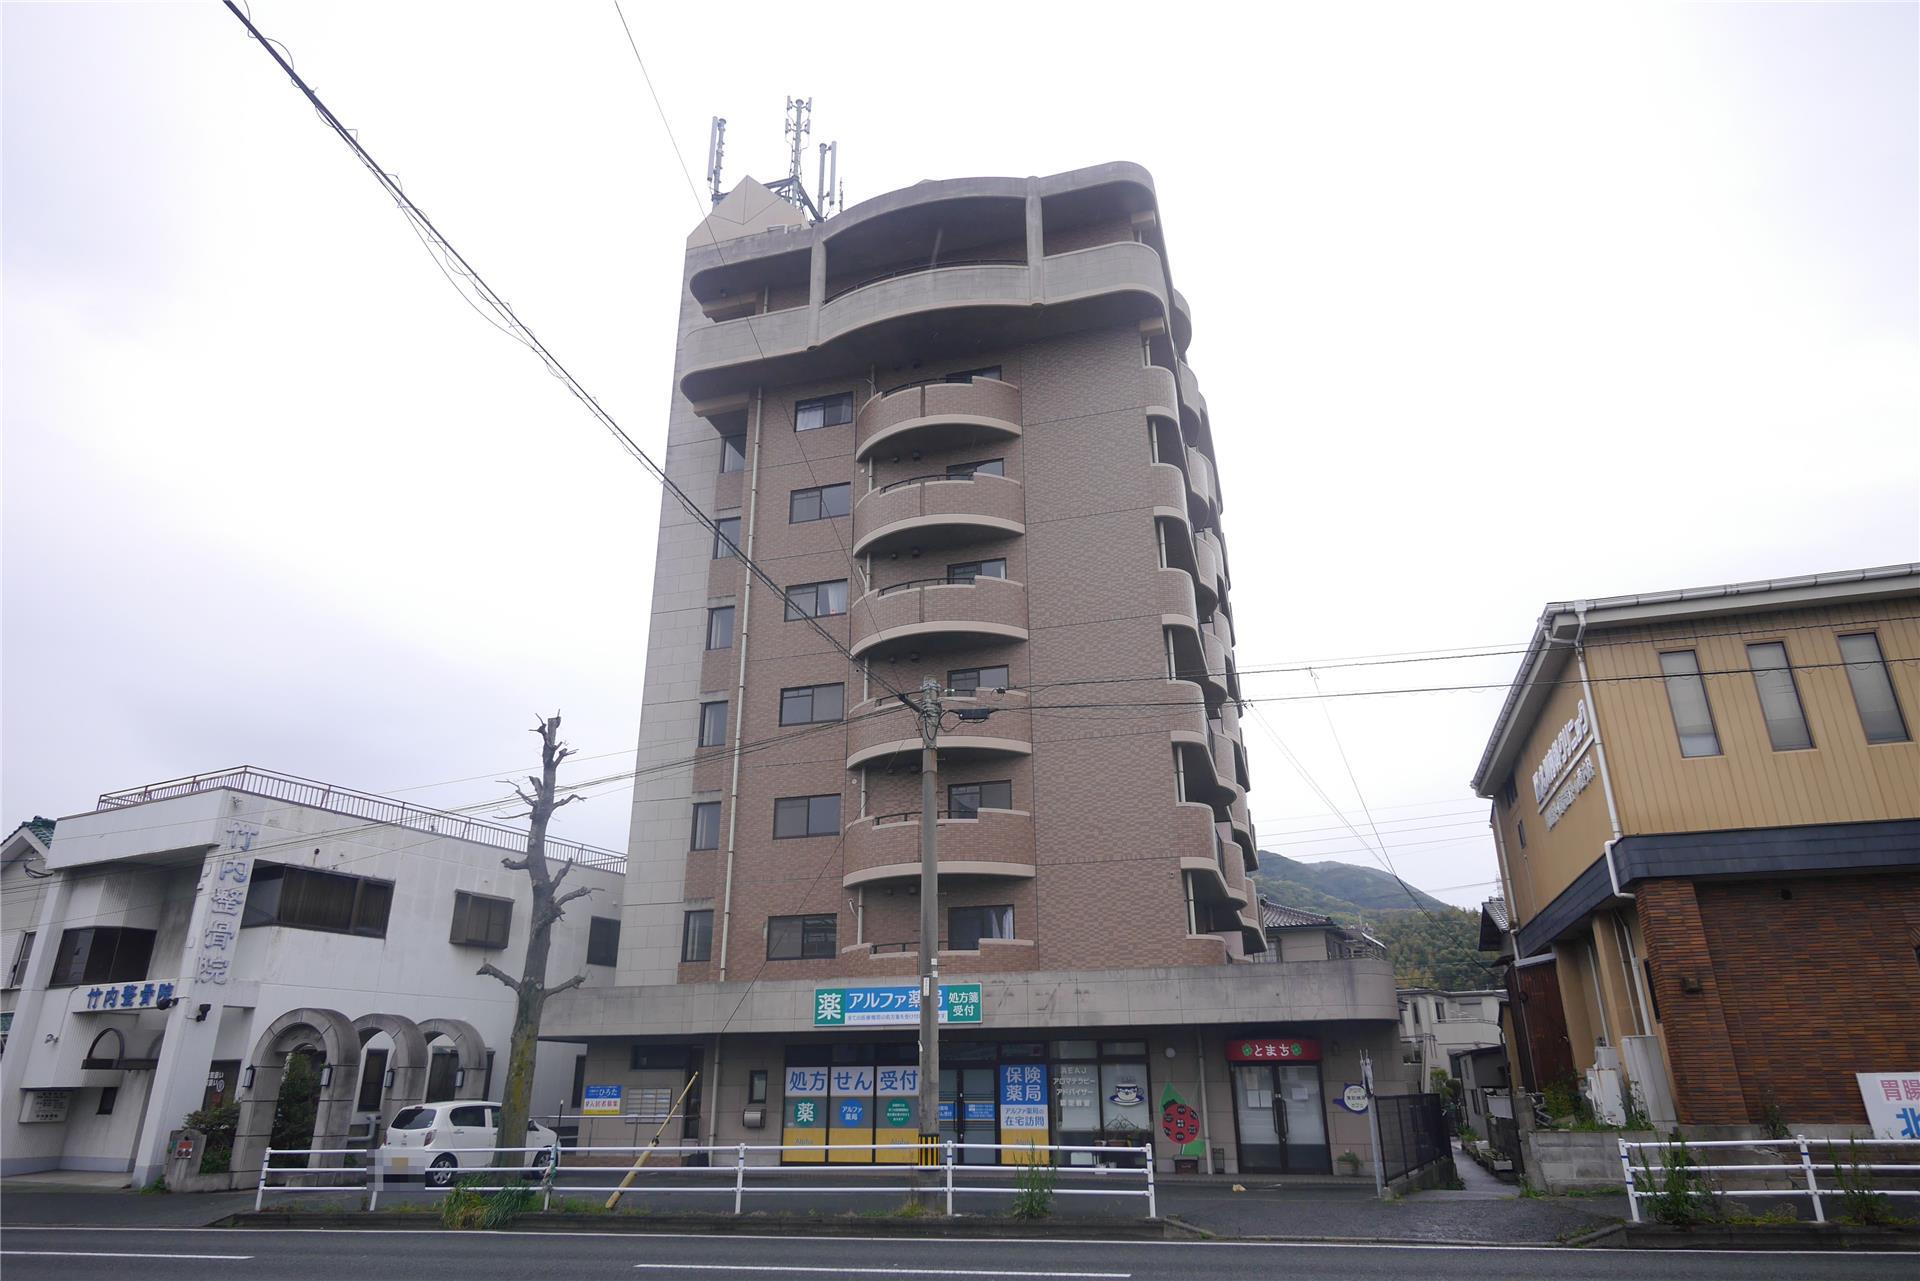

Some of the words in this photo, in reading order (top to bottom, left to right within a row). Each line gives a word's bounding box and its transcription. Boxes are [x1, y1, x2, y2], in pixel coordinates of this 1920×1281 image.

[195, 822, 259, 985] 竹内整骨院
[87, 983, 175, 1009] 竹内整骨院
[849, 990, 942, 1009] アルファ薬
[949, 992, 979, 1004] 処方箋
[817, 993, 842, 1020] 薬
[953, 1005, 975, 1017] 受付
[1254, 1043, 1290, 1057] とまち
[1006, 1067, 1041, 1084] 保険
[1006, 1085, 1041, 1101] 薬局
[1880, 1080, 1920, 1101] 胃腸
[797, 1103, 814, 1122] 薬
[842, 1106, 863, 1114] アルファ
[1005, 1115, 1045, 1127] 在宅訪問
